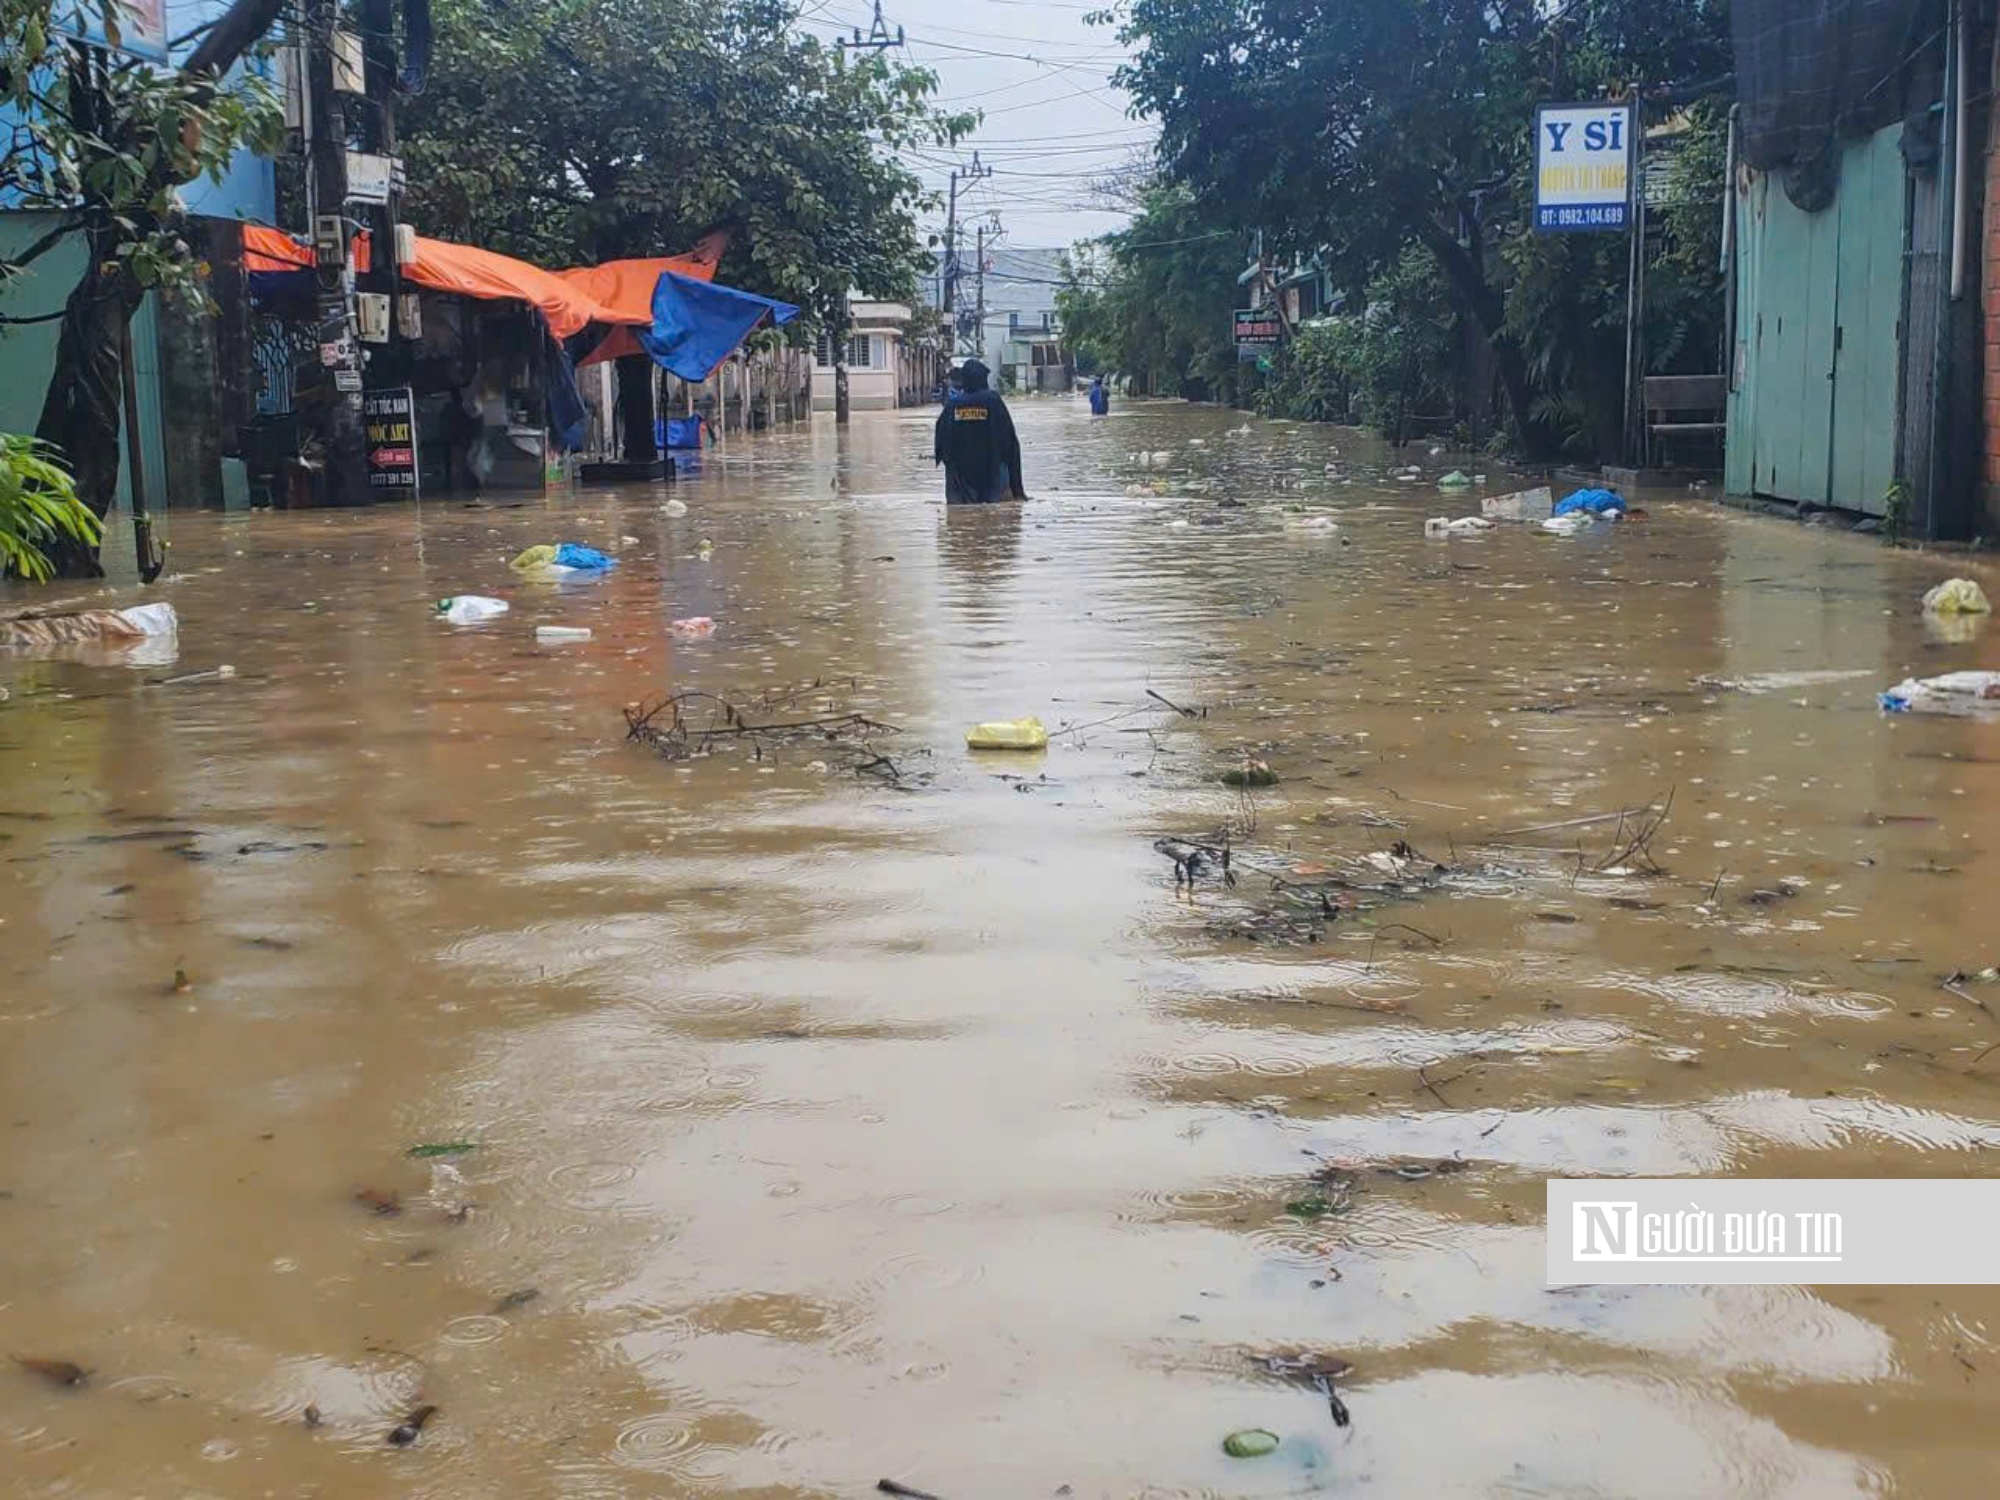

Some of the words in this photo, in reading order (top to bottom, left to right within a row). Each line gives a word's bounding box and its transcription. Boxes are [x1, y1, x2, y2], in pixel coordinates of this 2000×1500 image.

[1545, 122, 1572, 152] Y
[1584, 112, 1623, 151] SĨ
[390, 423, 409, 441] ART
